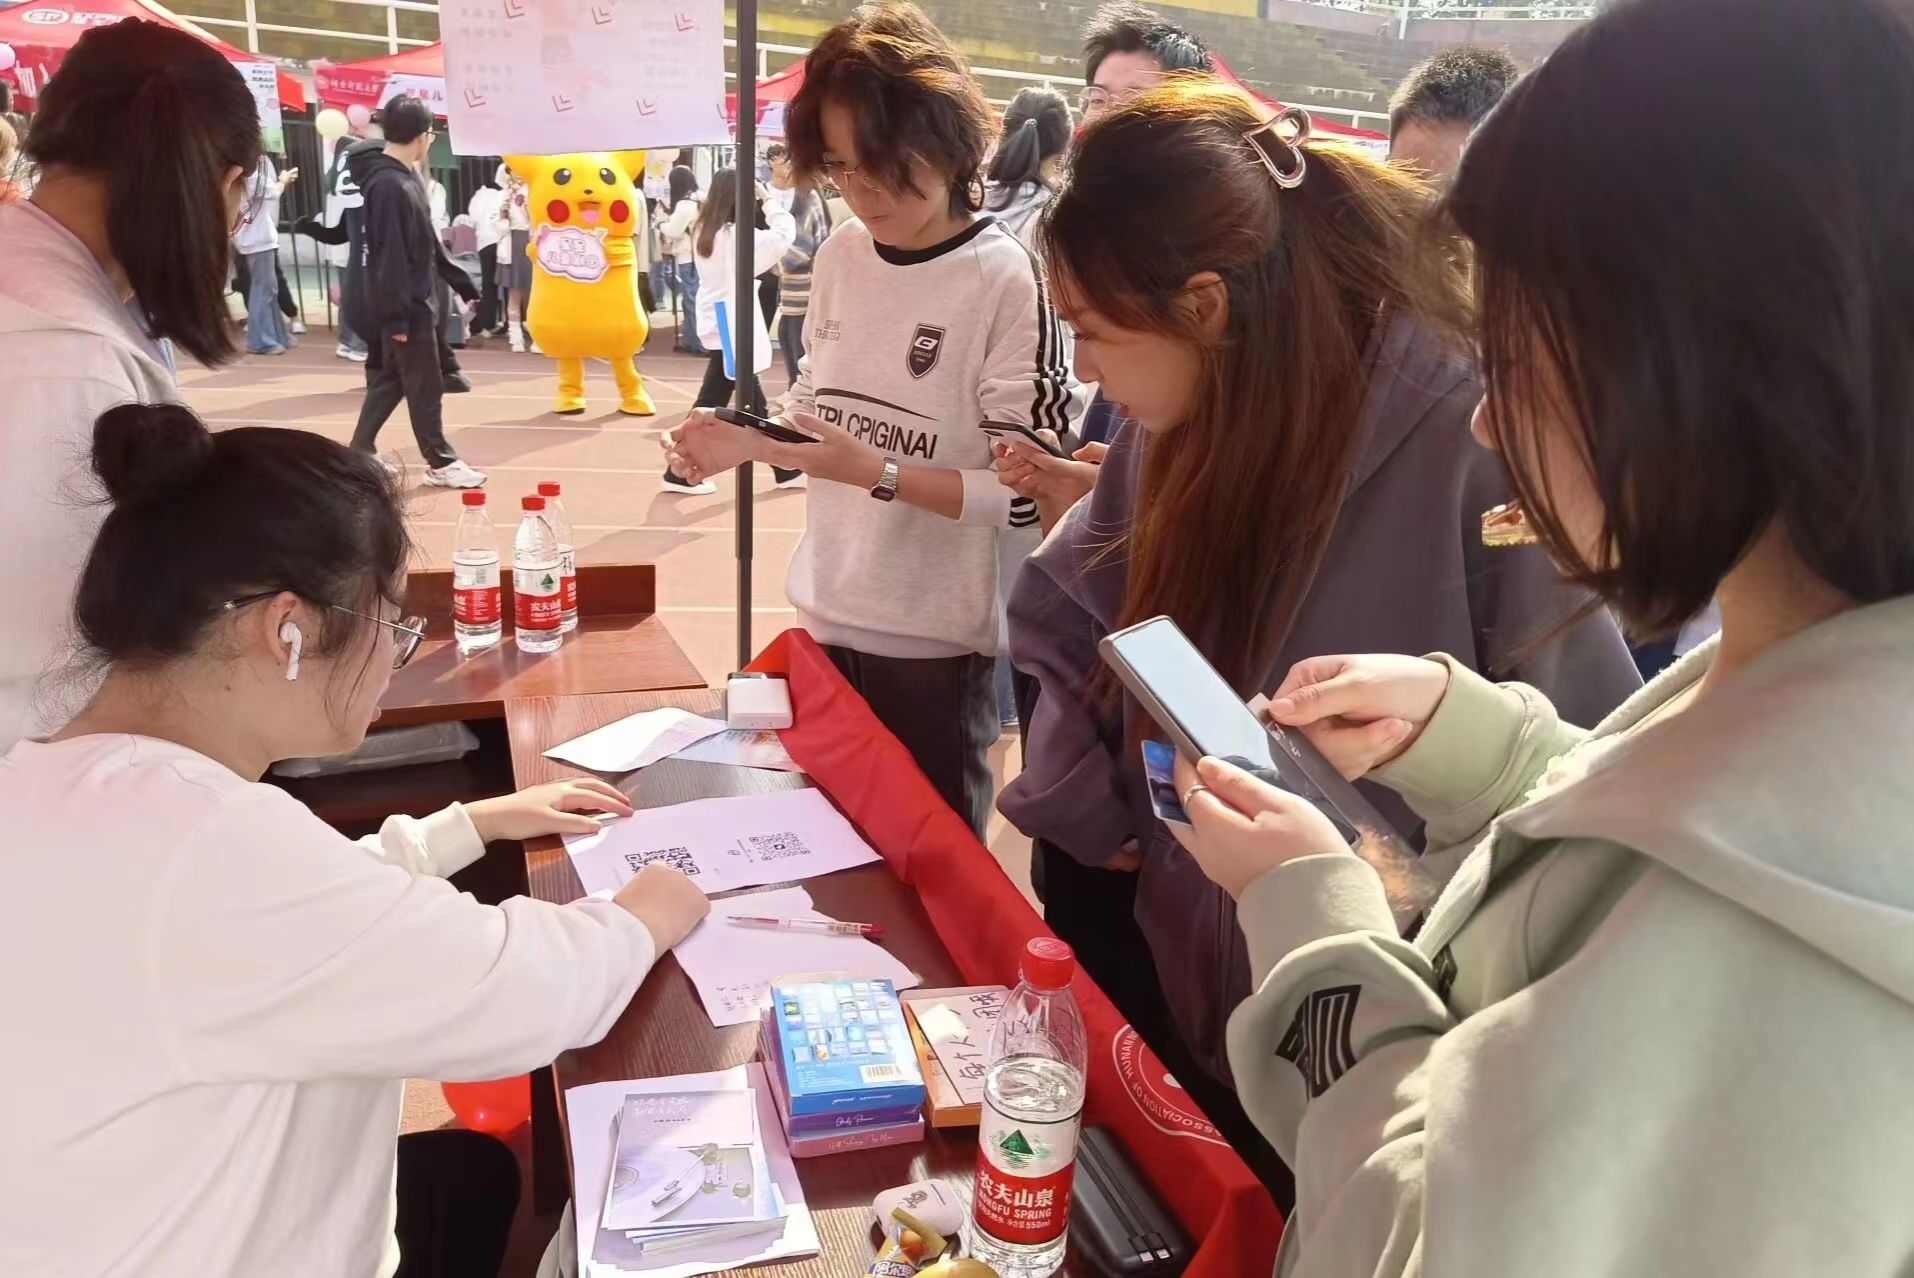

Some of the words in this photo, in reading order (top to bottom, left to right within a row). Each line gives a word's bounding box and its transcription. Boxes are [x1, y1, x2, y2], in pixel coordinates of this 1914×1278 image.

[980, 1170, 1054, 1208] 农夫山泉
[1014, 1208, 1052, 1220] SPRING
